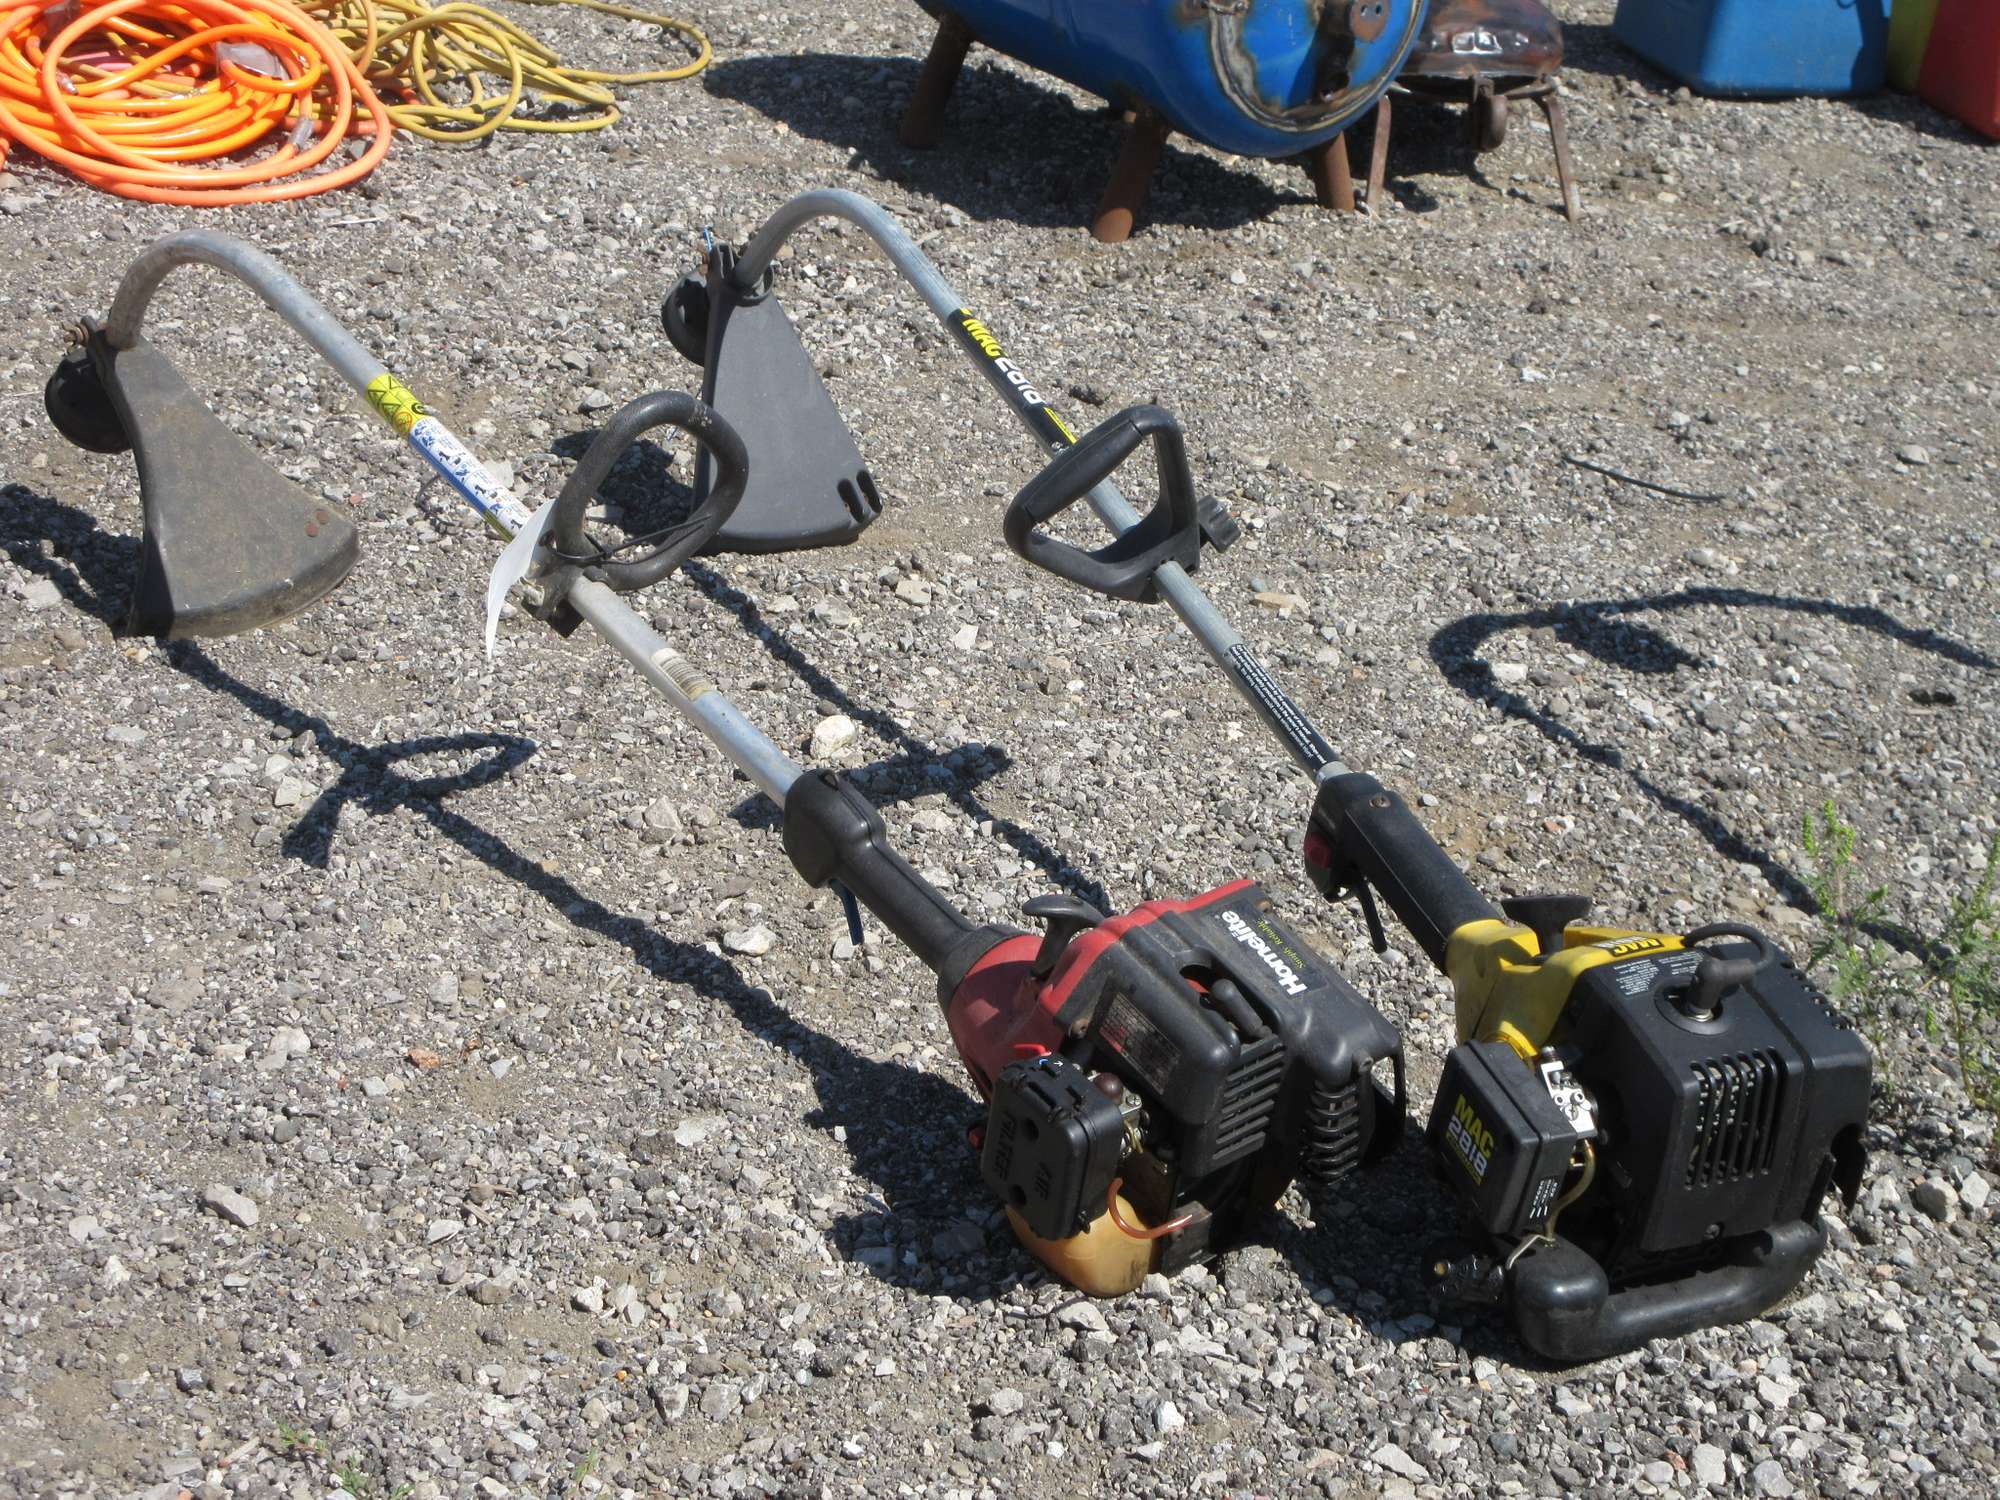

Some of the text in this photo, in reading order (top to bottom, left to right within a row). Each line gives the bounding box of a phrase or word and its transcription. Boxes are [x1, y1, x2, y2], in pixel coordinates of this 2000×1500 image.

[962, 318, 1007, 359] MAC
[1221, 910, 1308, 996] Homelite
[1613, 938, 1661, 954] MAC
[1449, 1117, 1488, 1177] 2818
[1454, 1094, 1495, 1160] MAC
